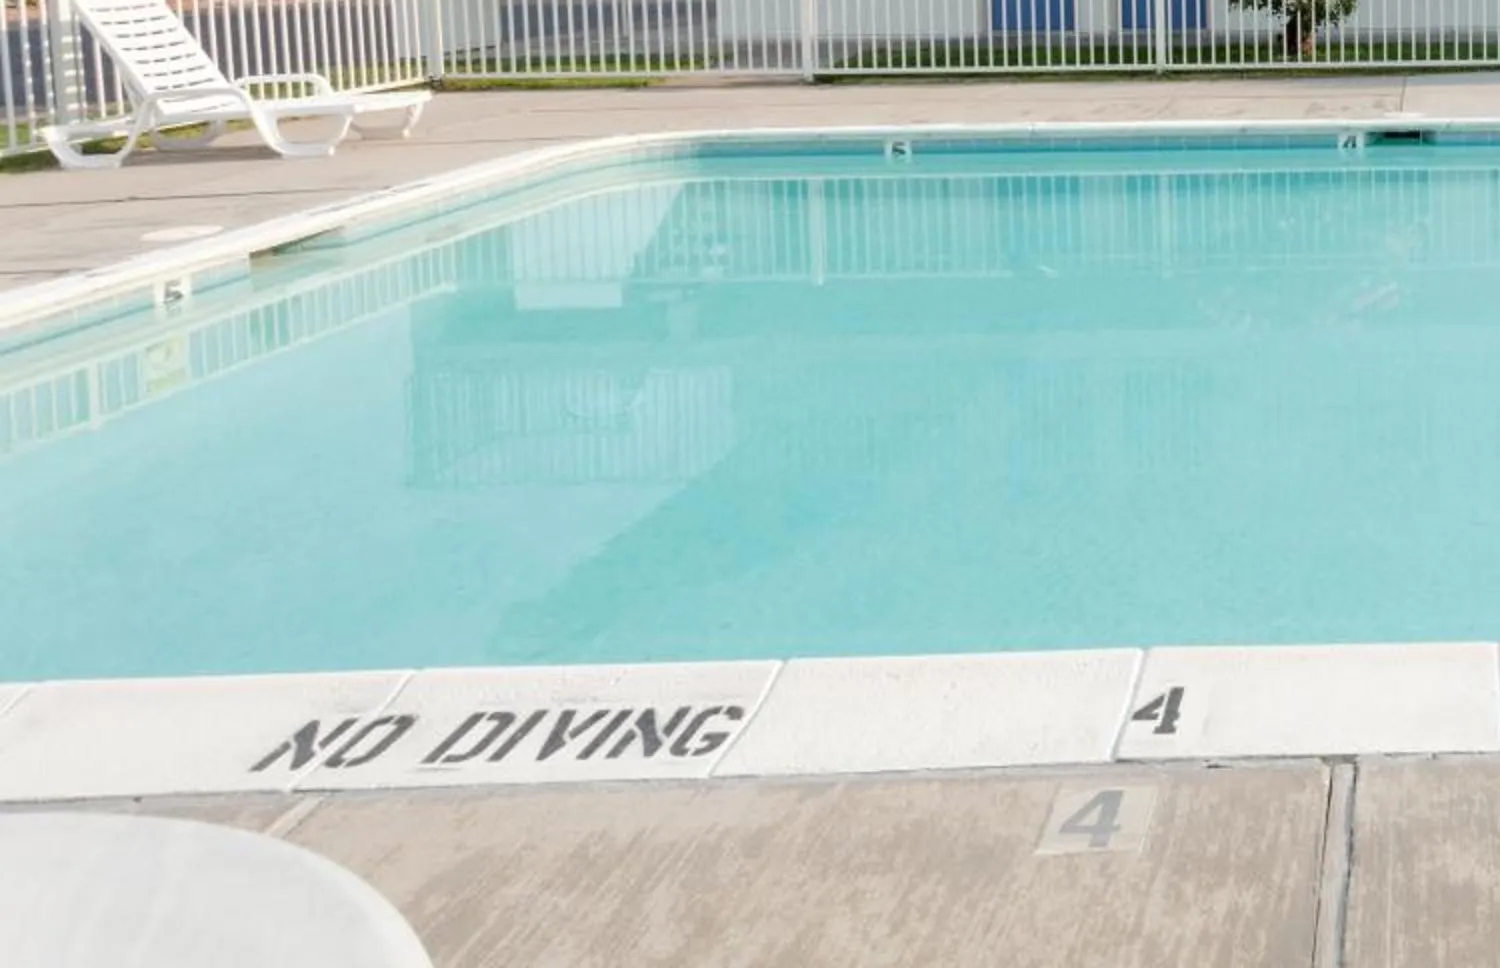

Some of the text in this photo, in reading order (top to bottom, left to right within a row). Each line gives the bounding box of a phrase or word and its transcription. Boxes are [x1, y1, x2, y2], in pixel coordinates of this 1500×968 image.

[163, 279, 184, 304] 5
[1131, 686, 1185, 734] 4
[248, 705, 745, 773] NO DIVING
[1058, 789, 1124, 848] 4
